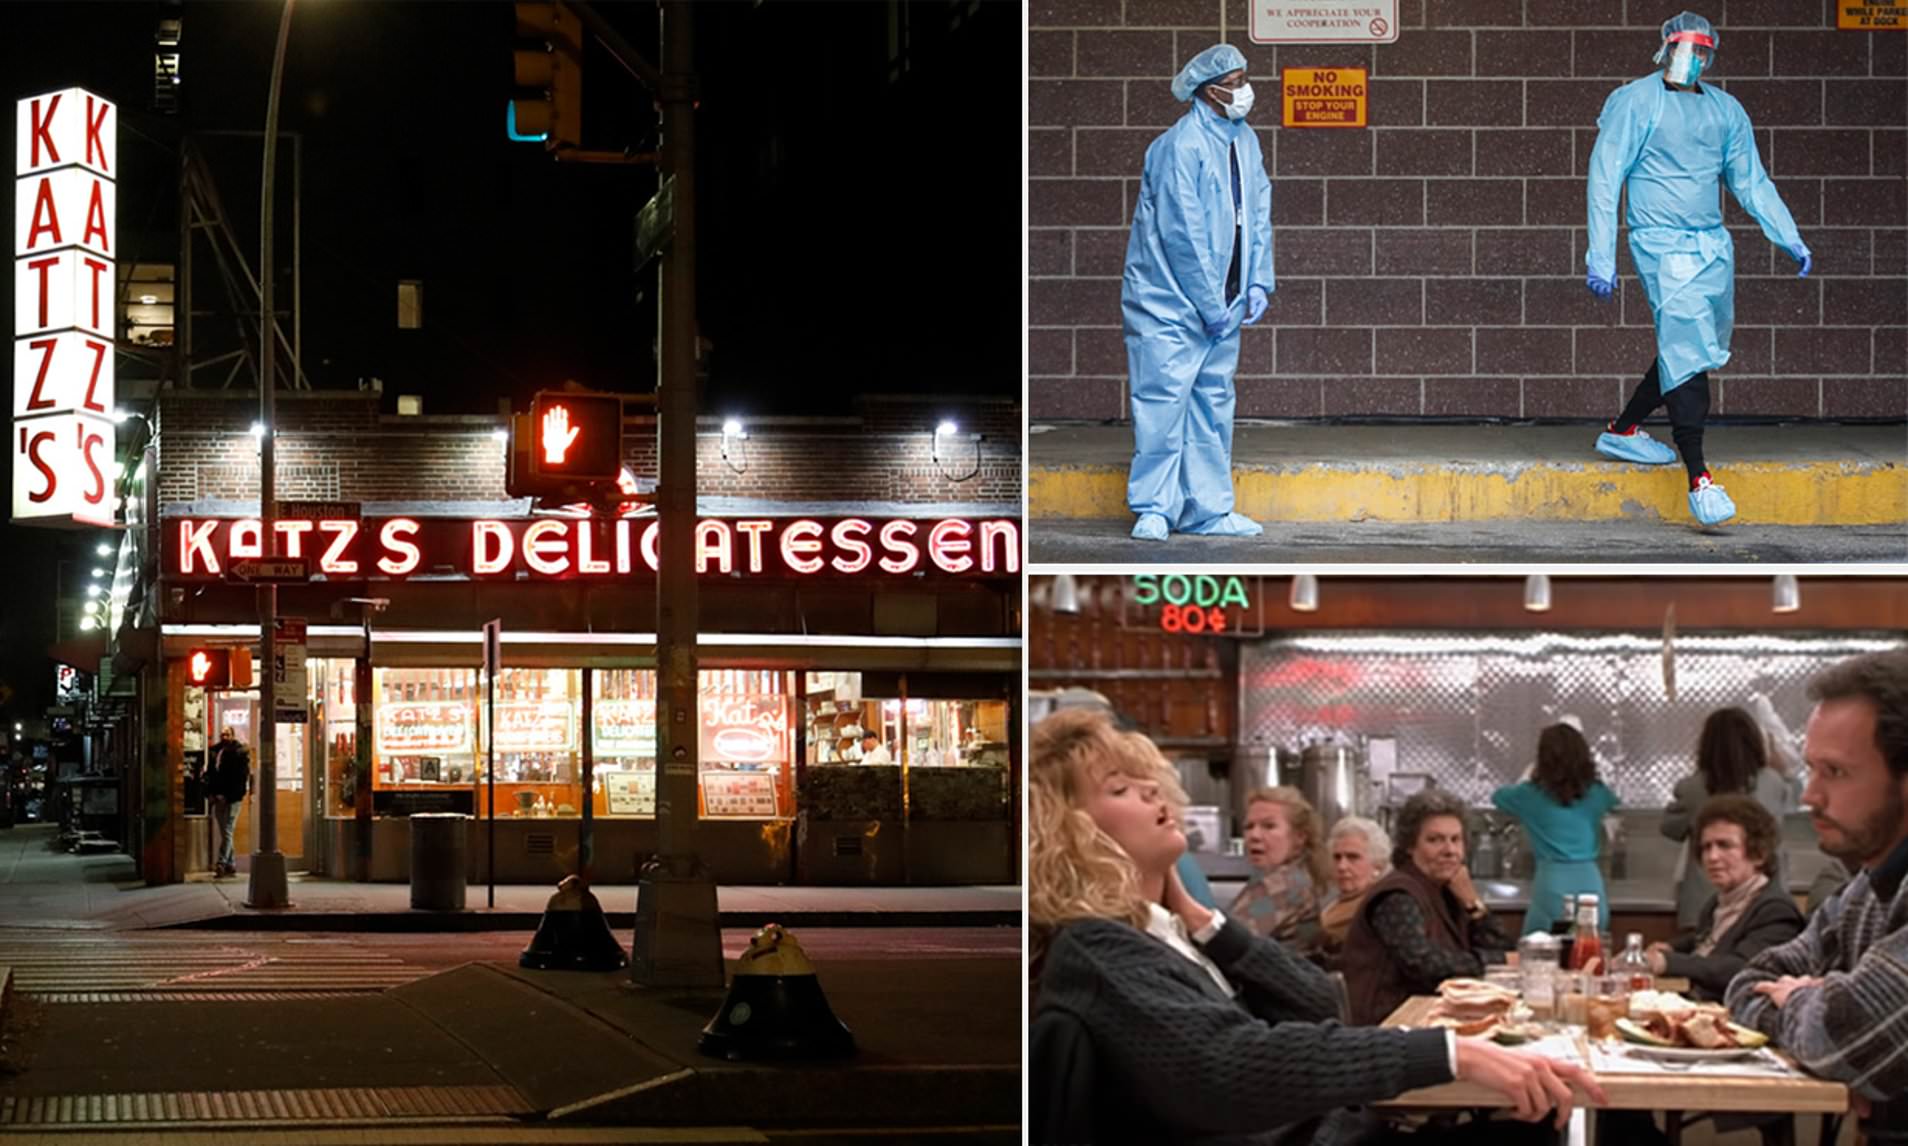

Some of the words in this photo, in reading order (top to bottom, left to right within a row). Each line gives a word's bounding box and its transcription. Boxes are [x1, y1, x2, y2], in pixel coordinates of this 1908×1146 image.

[1267, 9, 1283, 17] WE
[1287, 9, 1349, 17] APPRECIATE
[1286, 19, 1361, 28] COOPERATION
[1313, 72, 1338, 83] NO
[1286, 85, 1364, 97] SMOKING
[1296, 102, 1324, 110] STOP
[1327, 102, 1355, 110] YOUR
[1305, 112, 1345, 120] ENGINE
[19, 94, 63, 504] KATZ'S
[77, 95, 110, 505] KATZ'S
[291, 503, 345, 518] Houston
[273, 565, 300, 575] WAY
[1134, 574, 1249, 609] SODA
[1161, 604, 1227, 634] 80¢
